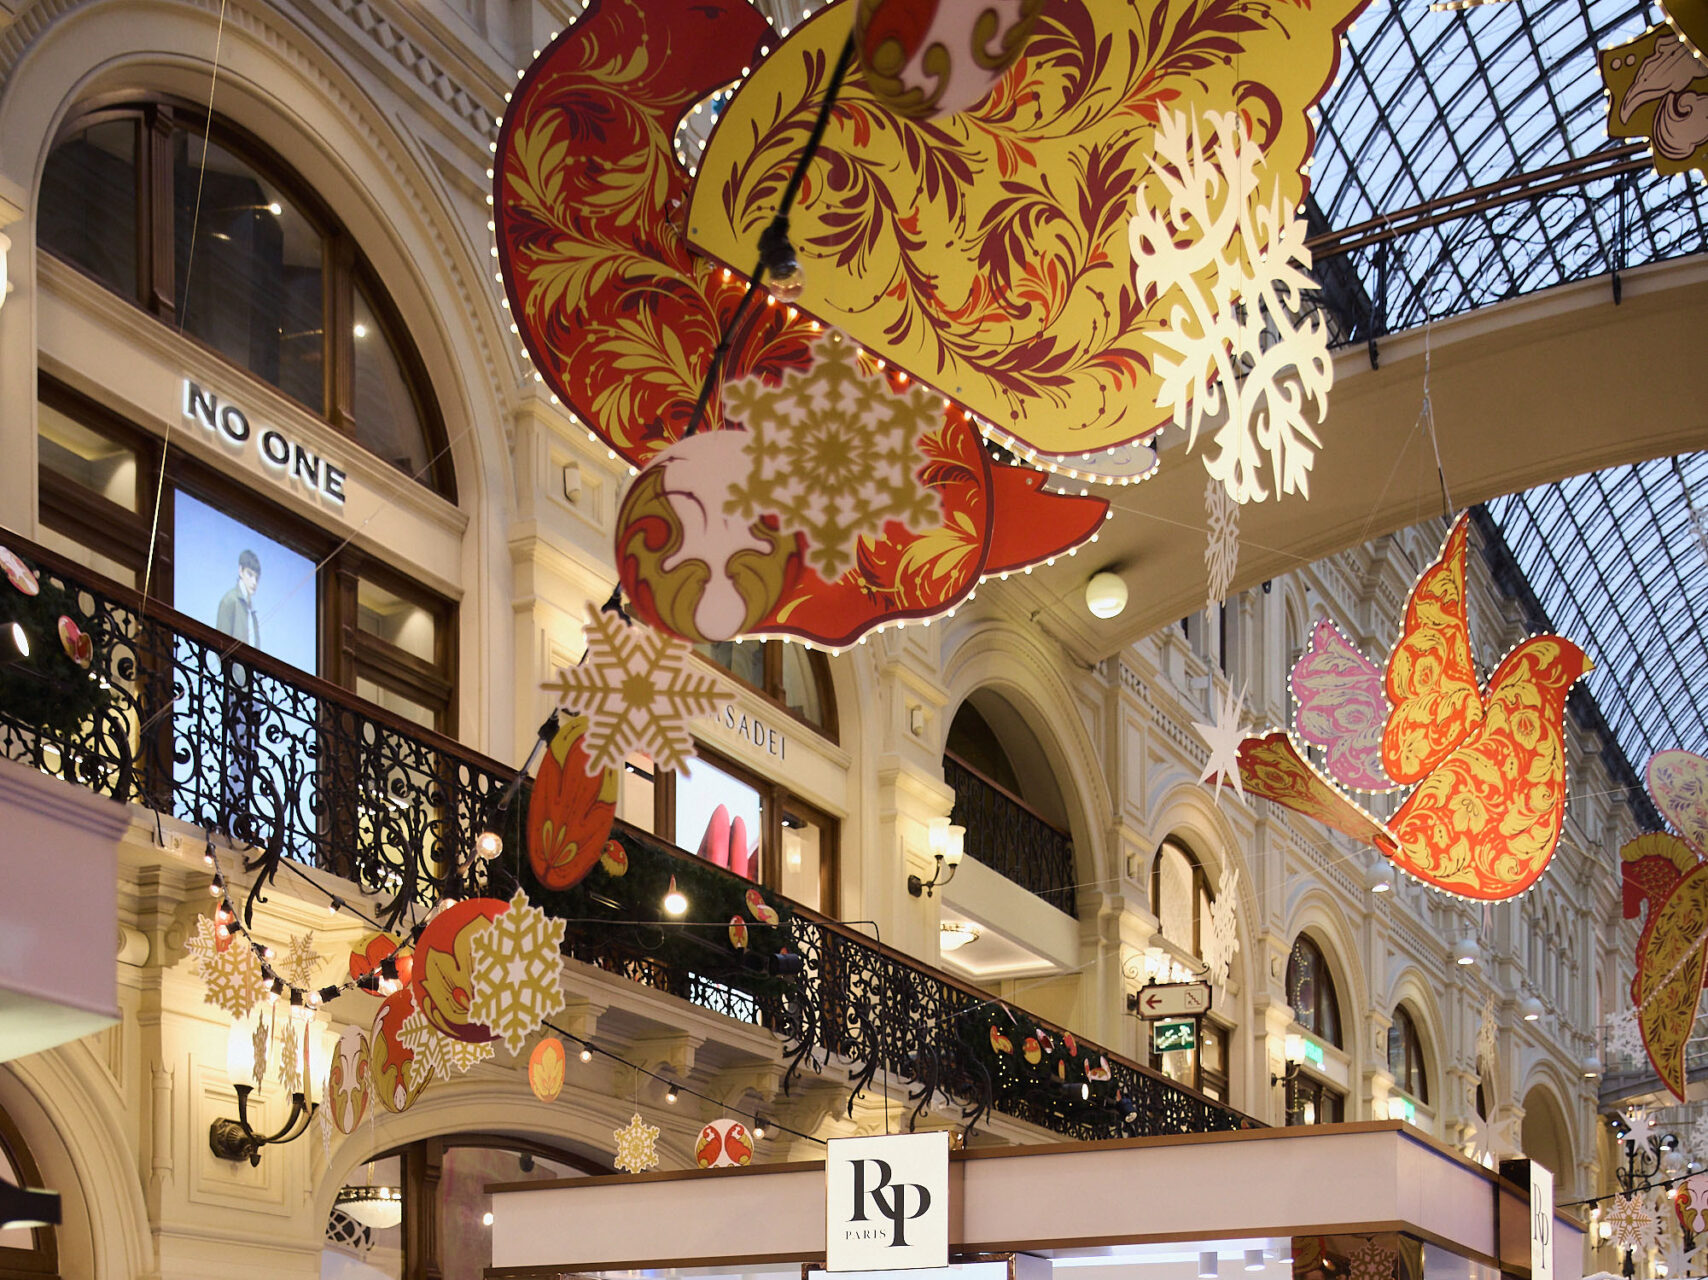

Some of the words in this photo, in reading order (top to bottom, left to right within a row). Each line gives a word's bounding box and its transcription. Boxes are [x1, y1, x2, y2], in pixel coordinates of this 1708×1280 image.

[184, 379, 250, 444] NO
[258, 429, 346, 505] ONE
[709, 704, 785, 761] SADEI
[844, 1229, 887, 1240] PARIS
